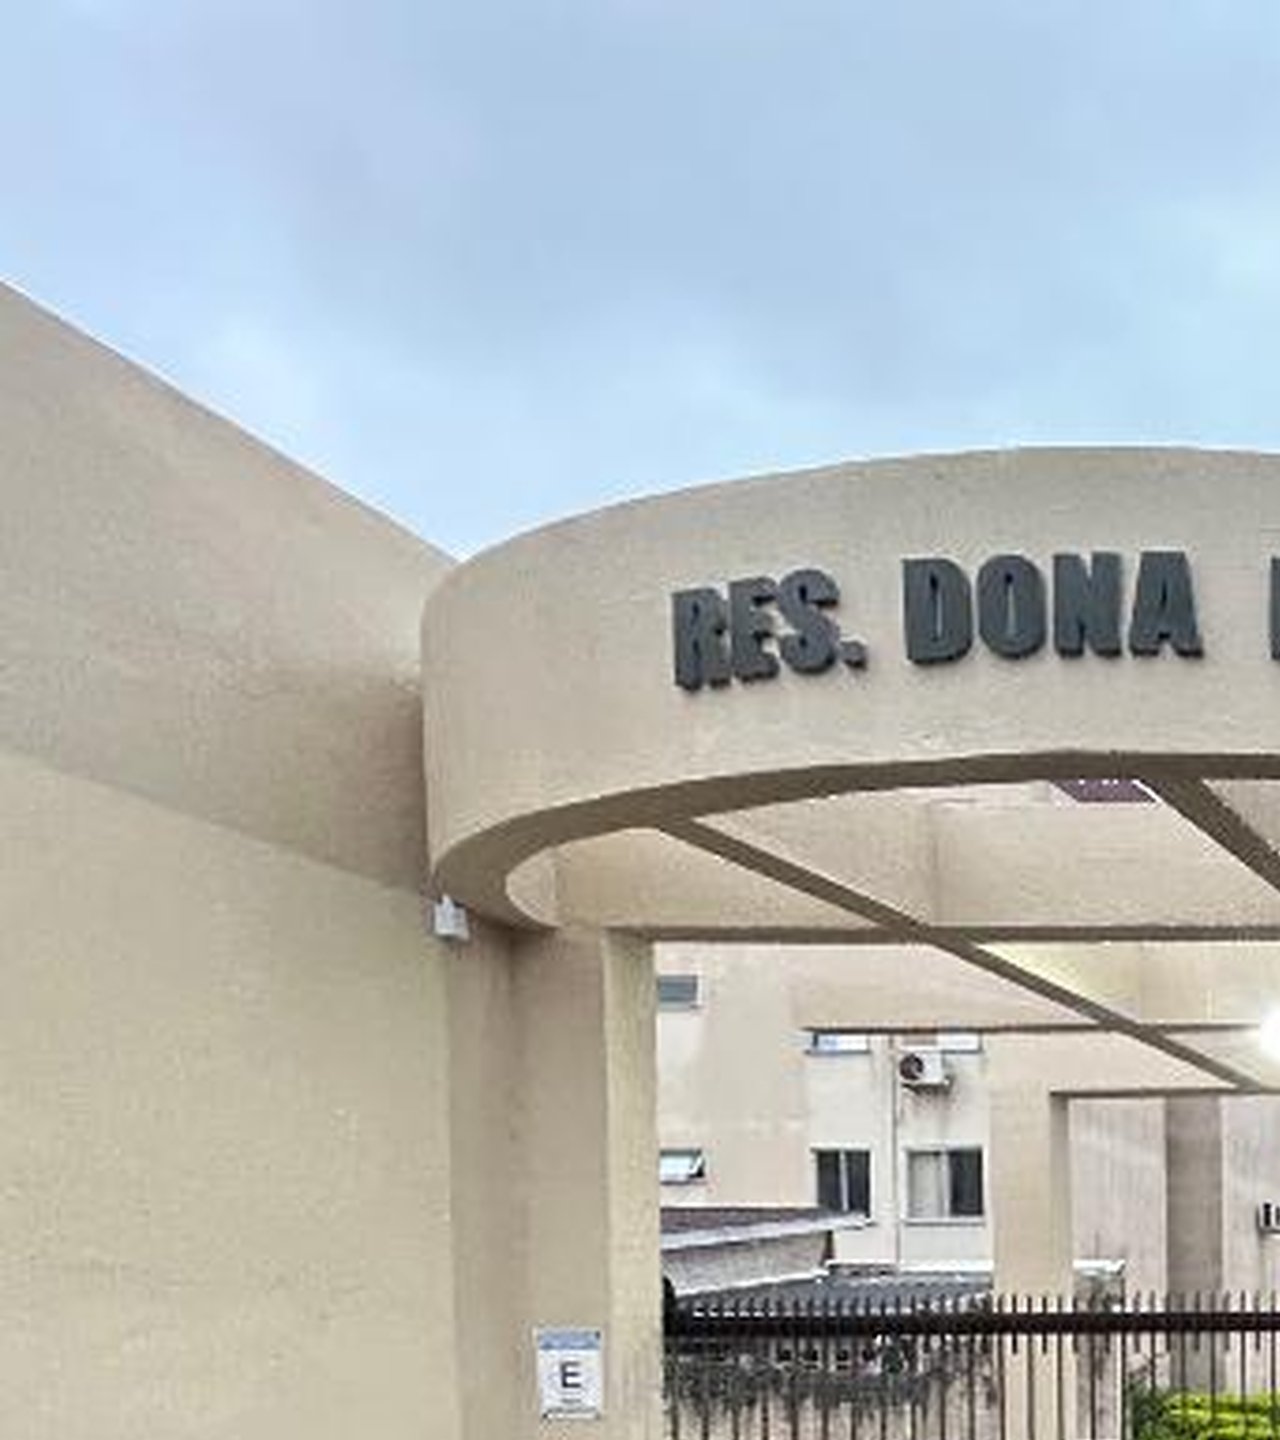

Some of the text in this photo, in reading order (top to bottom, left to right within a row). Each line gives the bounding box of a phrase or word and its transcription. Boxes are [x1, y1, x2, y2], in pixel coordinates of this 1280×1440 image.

[671, 568, 868, 693] RES.
[901, 550, 1204, 666] DONA
[561, 1360, 582, 1388] E
